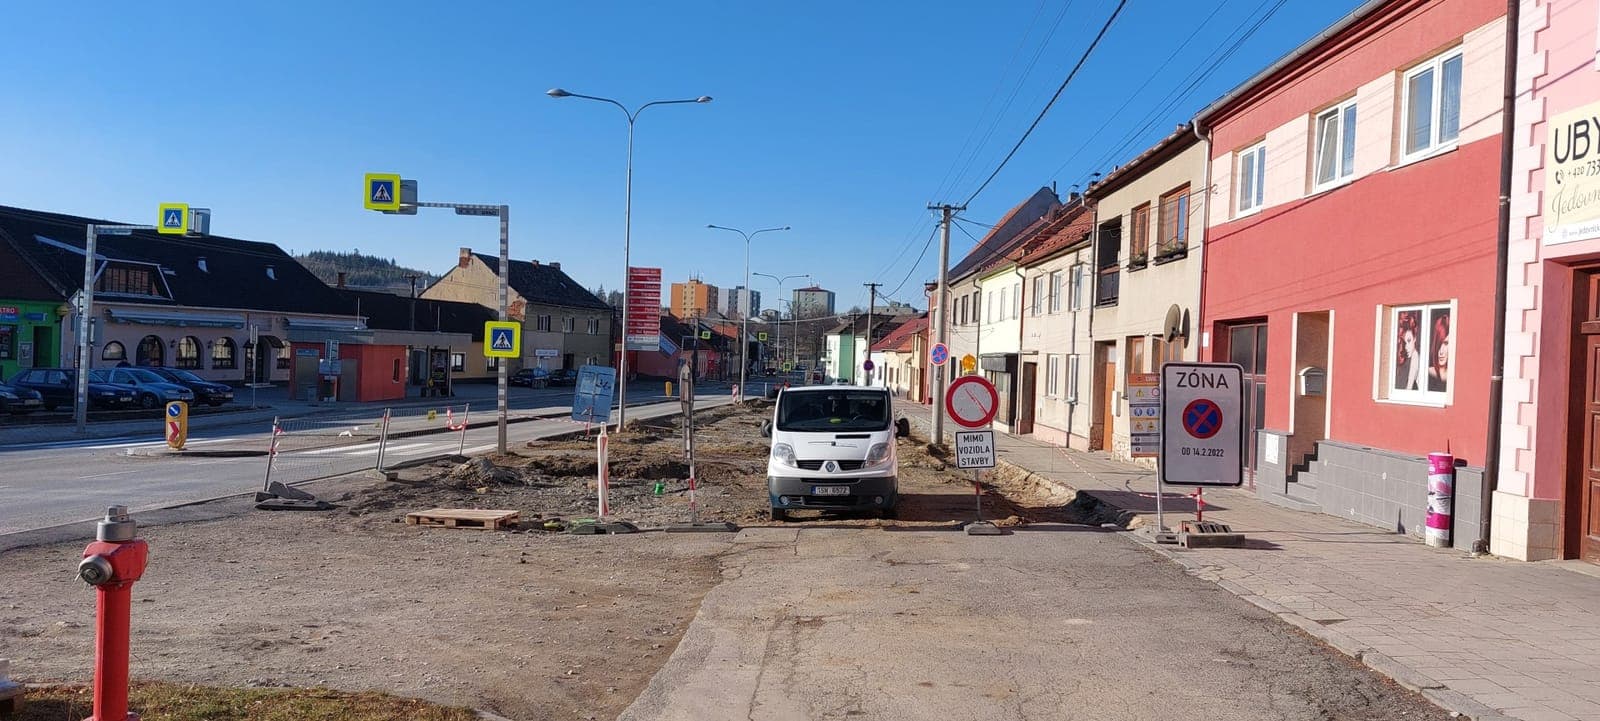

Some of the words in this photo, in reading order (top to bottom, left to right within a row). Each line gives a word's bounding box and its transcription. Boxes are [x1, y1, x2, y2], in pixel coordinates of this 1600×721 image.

[1176, 369, 1229, 389] ZÓNA
[963, 434, 984, 443] MIMO
[959, 445, 991, 454] VOZIDLA
[1181, 447, 1191, 456] OD
[1193, 447, 1225, 457] 14.2.2022
[961, 457, 989, 465] STAVBY
